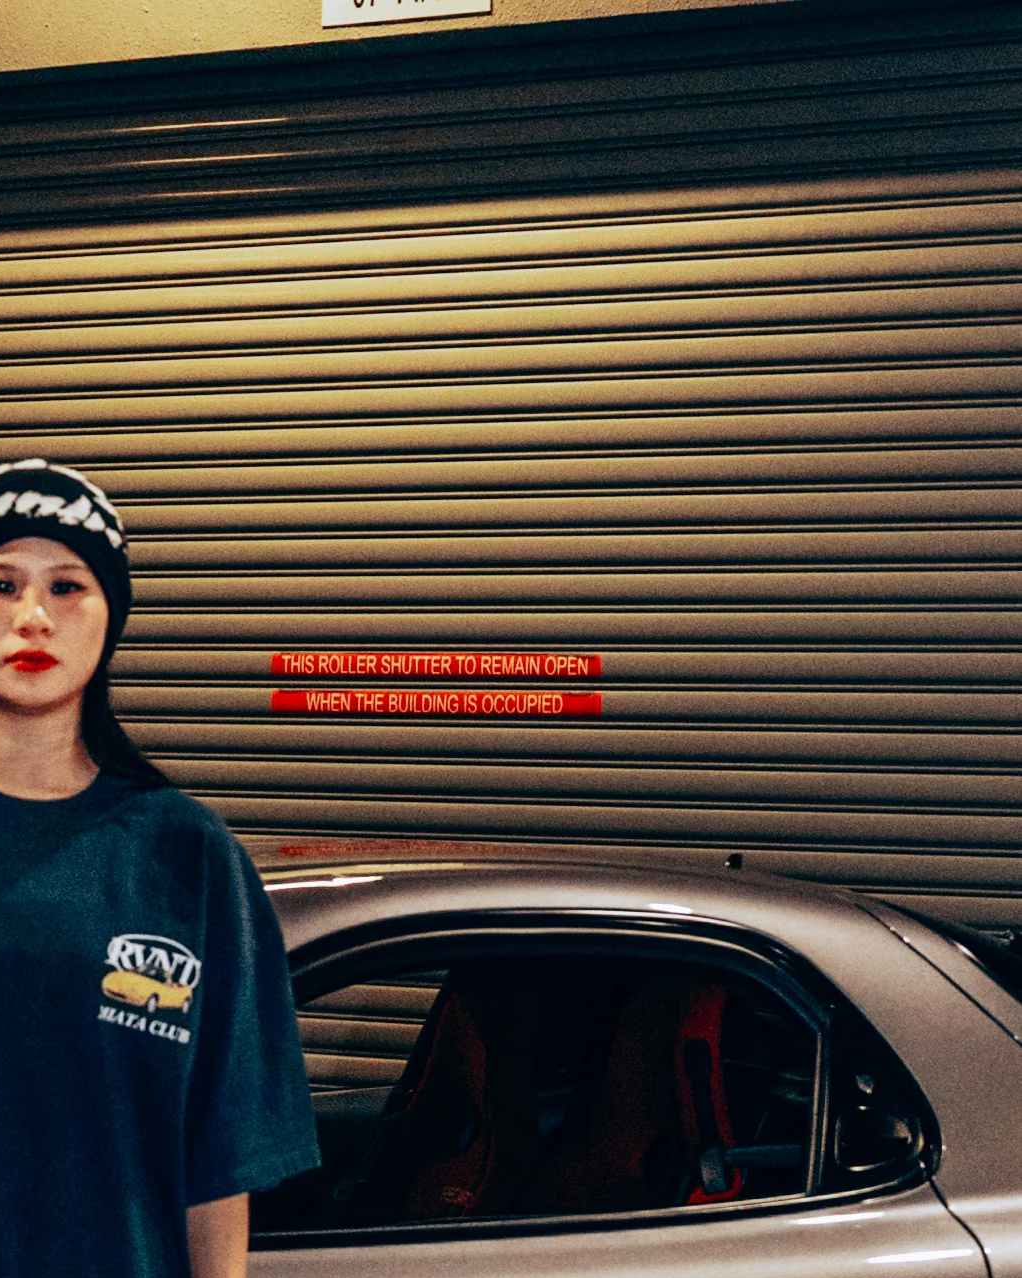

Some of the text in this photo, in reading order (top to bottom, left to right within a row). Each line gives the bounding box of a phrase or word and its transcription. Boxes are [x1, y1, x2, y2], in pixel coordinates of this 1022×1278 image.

[281, 655, 589, 676] THIS ROLLER SHUTTER TO REMAIN OPEN
[306, 692, 564, 714] WHEN THE BUILDING IS OCCUPIED
[148, 1019, 191, 1044] CLUB
